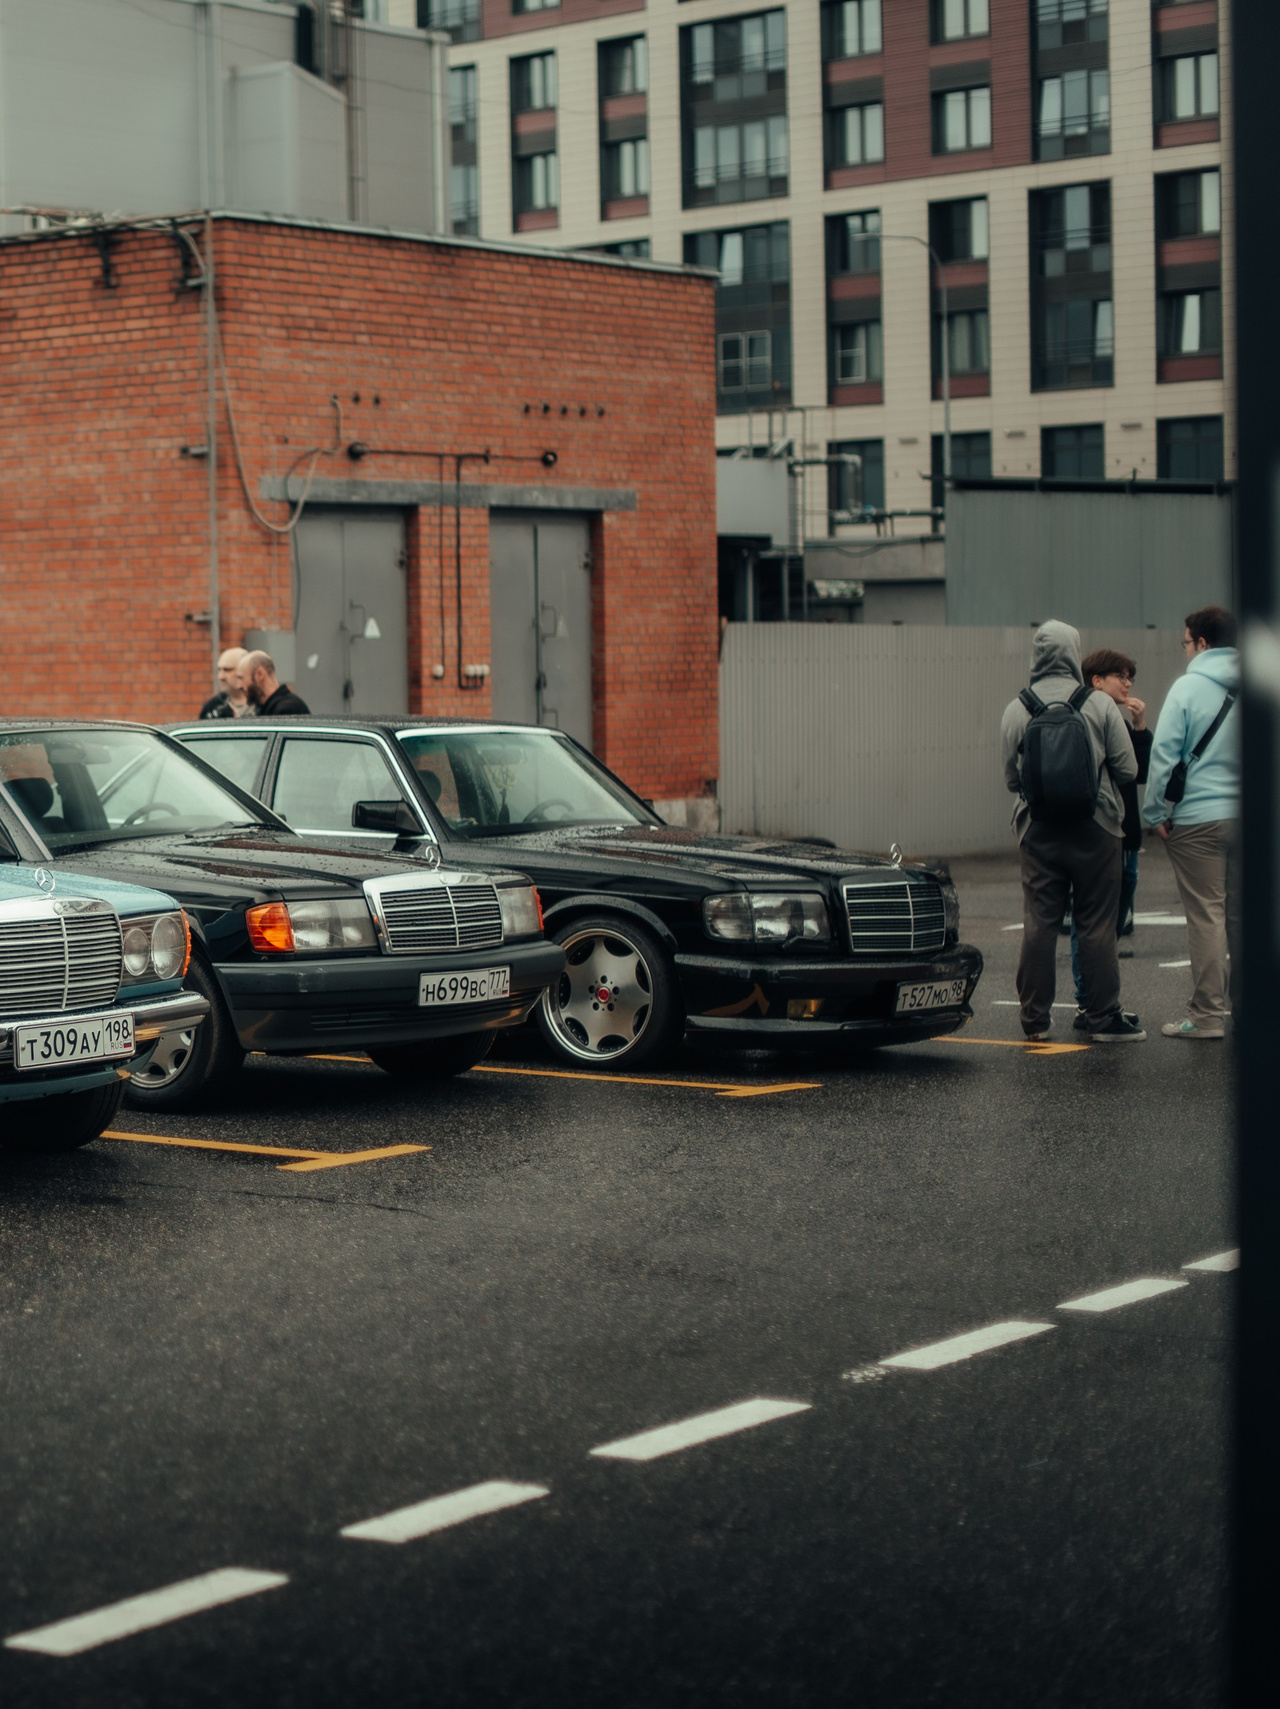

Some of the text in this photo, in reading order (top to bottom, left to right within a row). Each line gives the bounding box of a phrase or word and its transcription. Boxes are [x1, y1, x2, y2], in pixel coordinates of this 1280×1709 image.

[490, 970, 507, 989] 777
[952, 981, 963, 997] 98
[105, 1019, 130, 1042] 198
[110, 1041, 123, 1050] RUS
